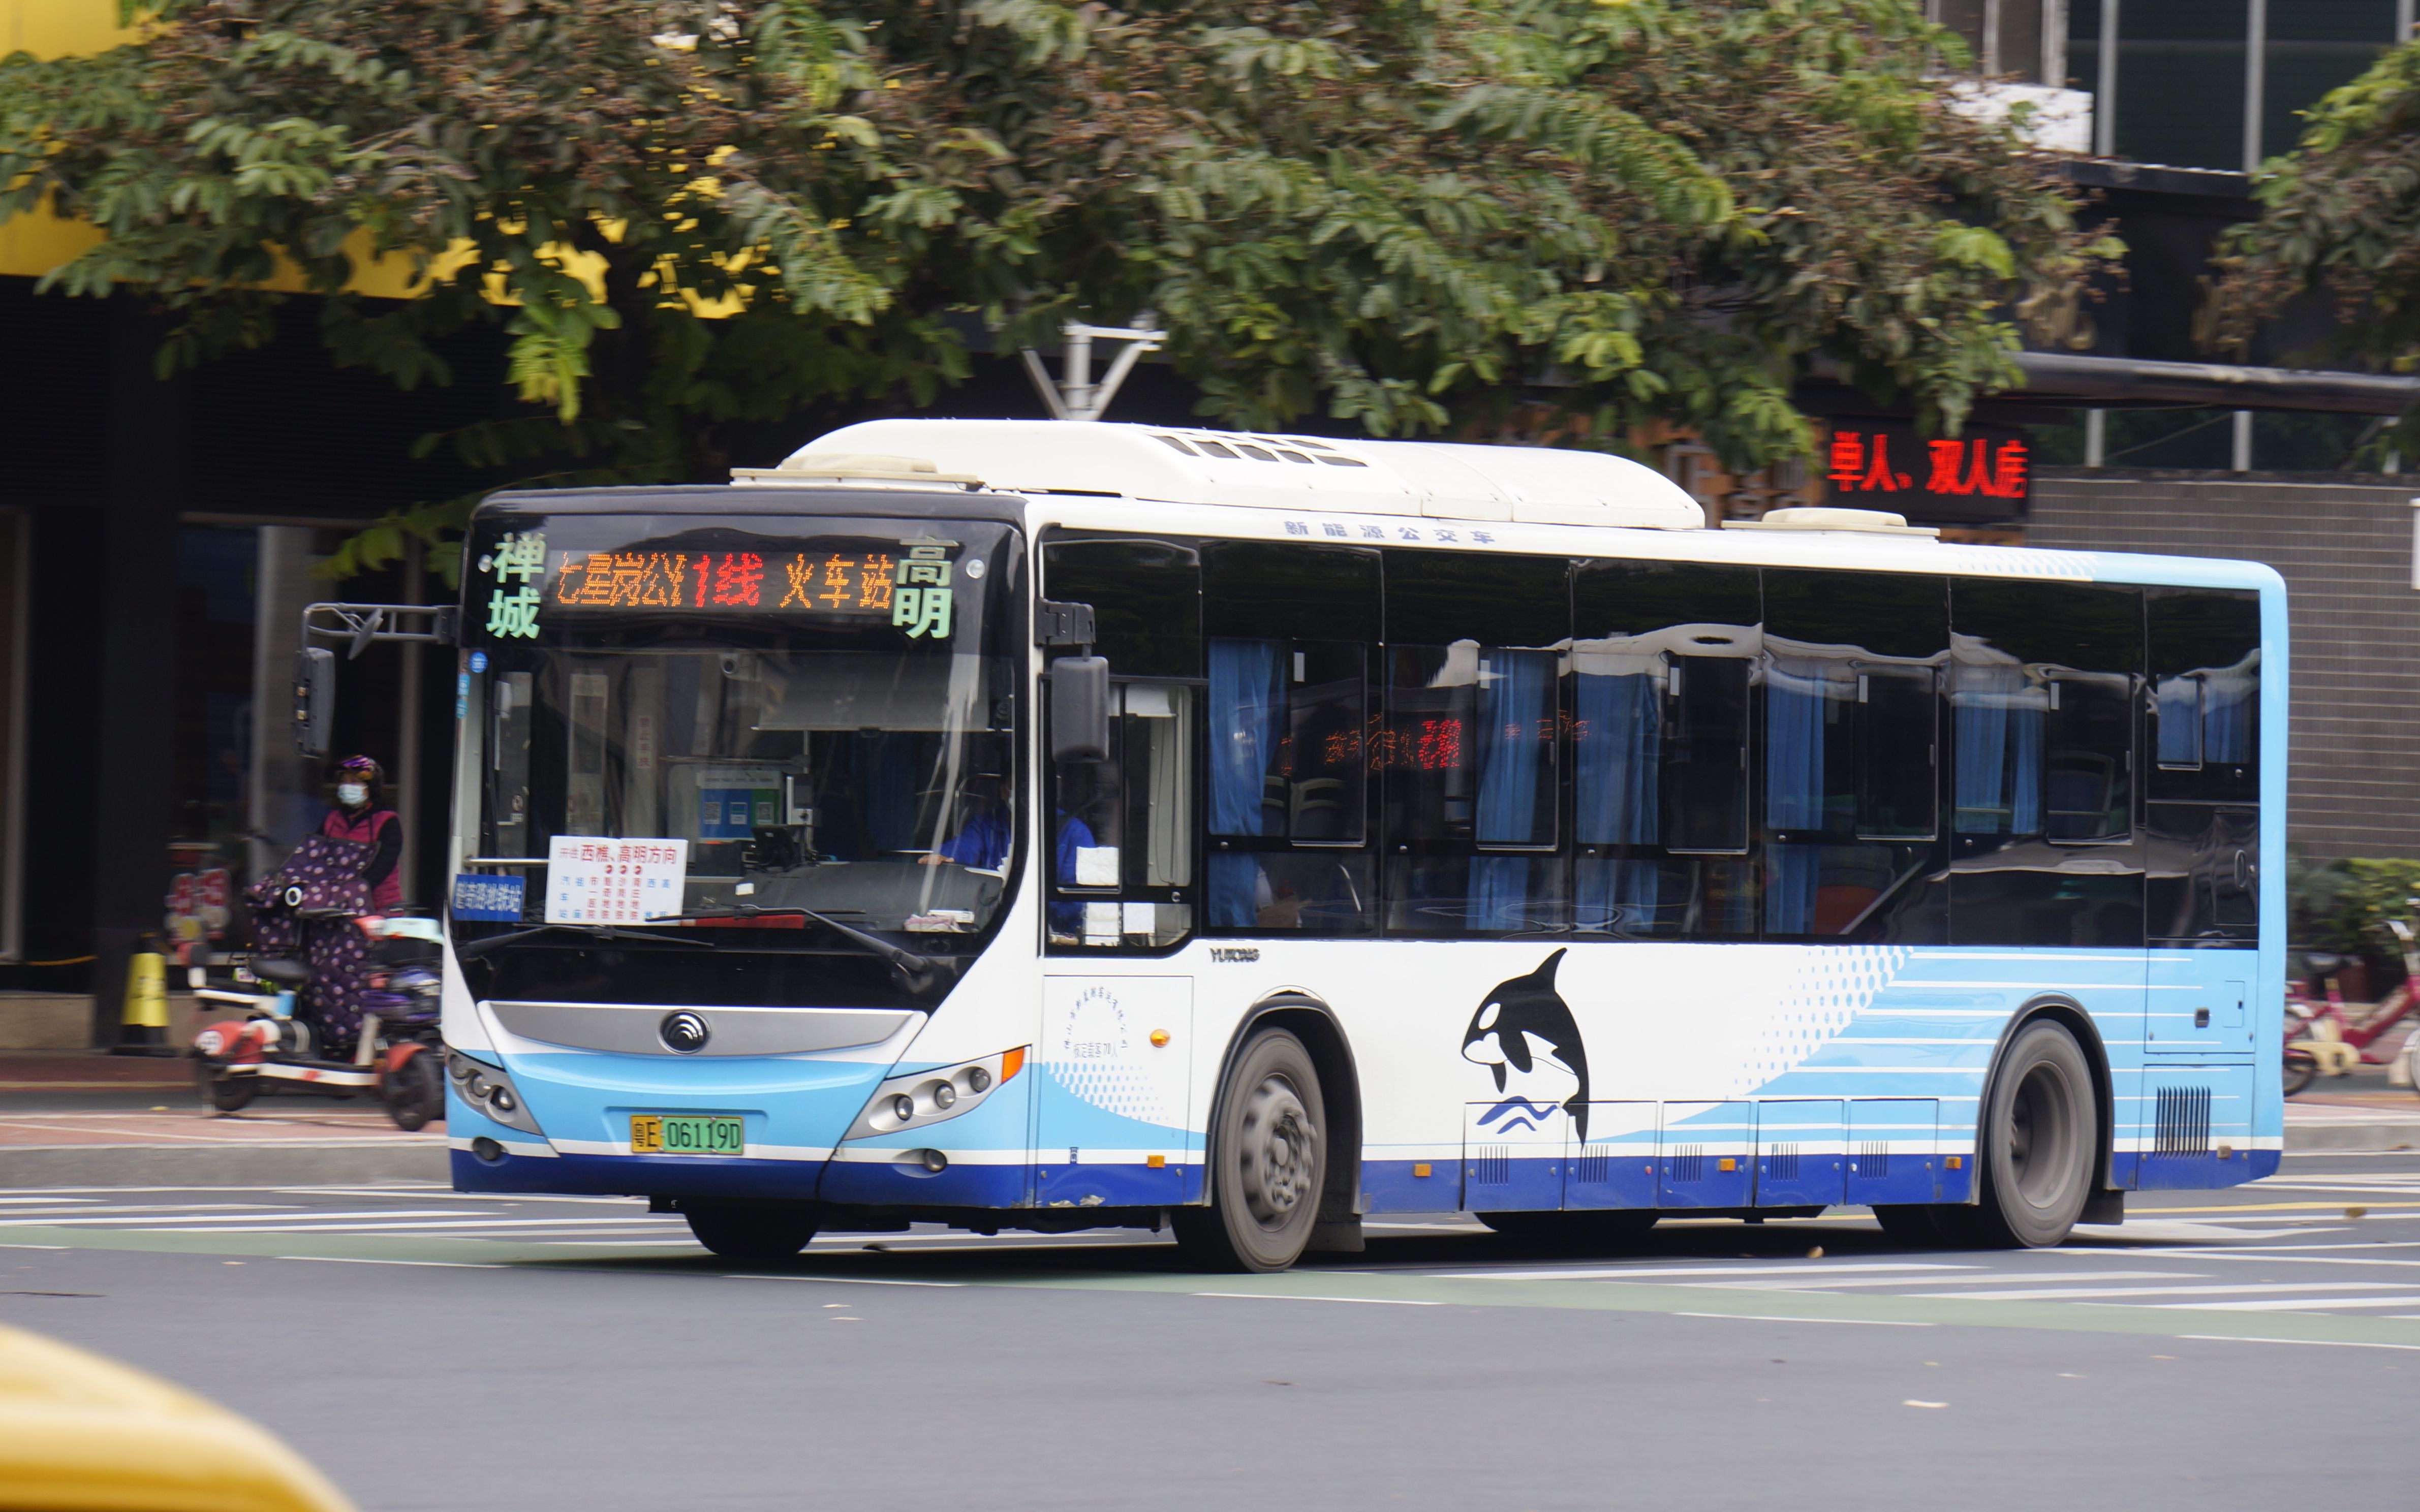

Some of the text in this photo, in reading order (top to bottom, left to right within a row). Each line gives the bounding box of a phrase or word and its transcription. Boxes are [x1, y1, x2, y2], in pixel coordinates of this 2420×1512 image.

[1283, 520, 1495, 544] 新能源公交车
[486, 531, 546, 639] 禅城
[693, 553, 764, 608] 1线
[780, 554, 894, 609] 火车站
[892, 535, 959, 639] 高明
